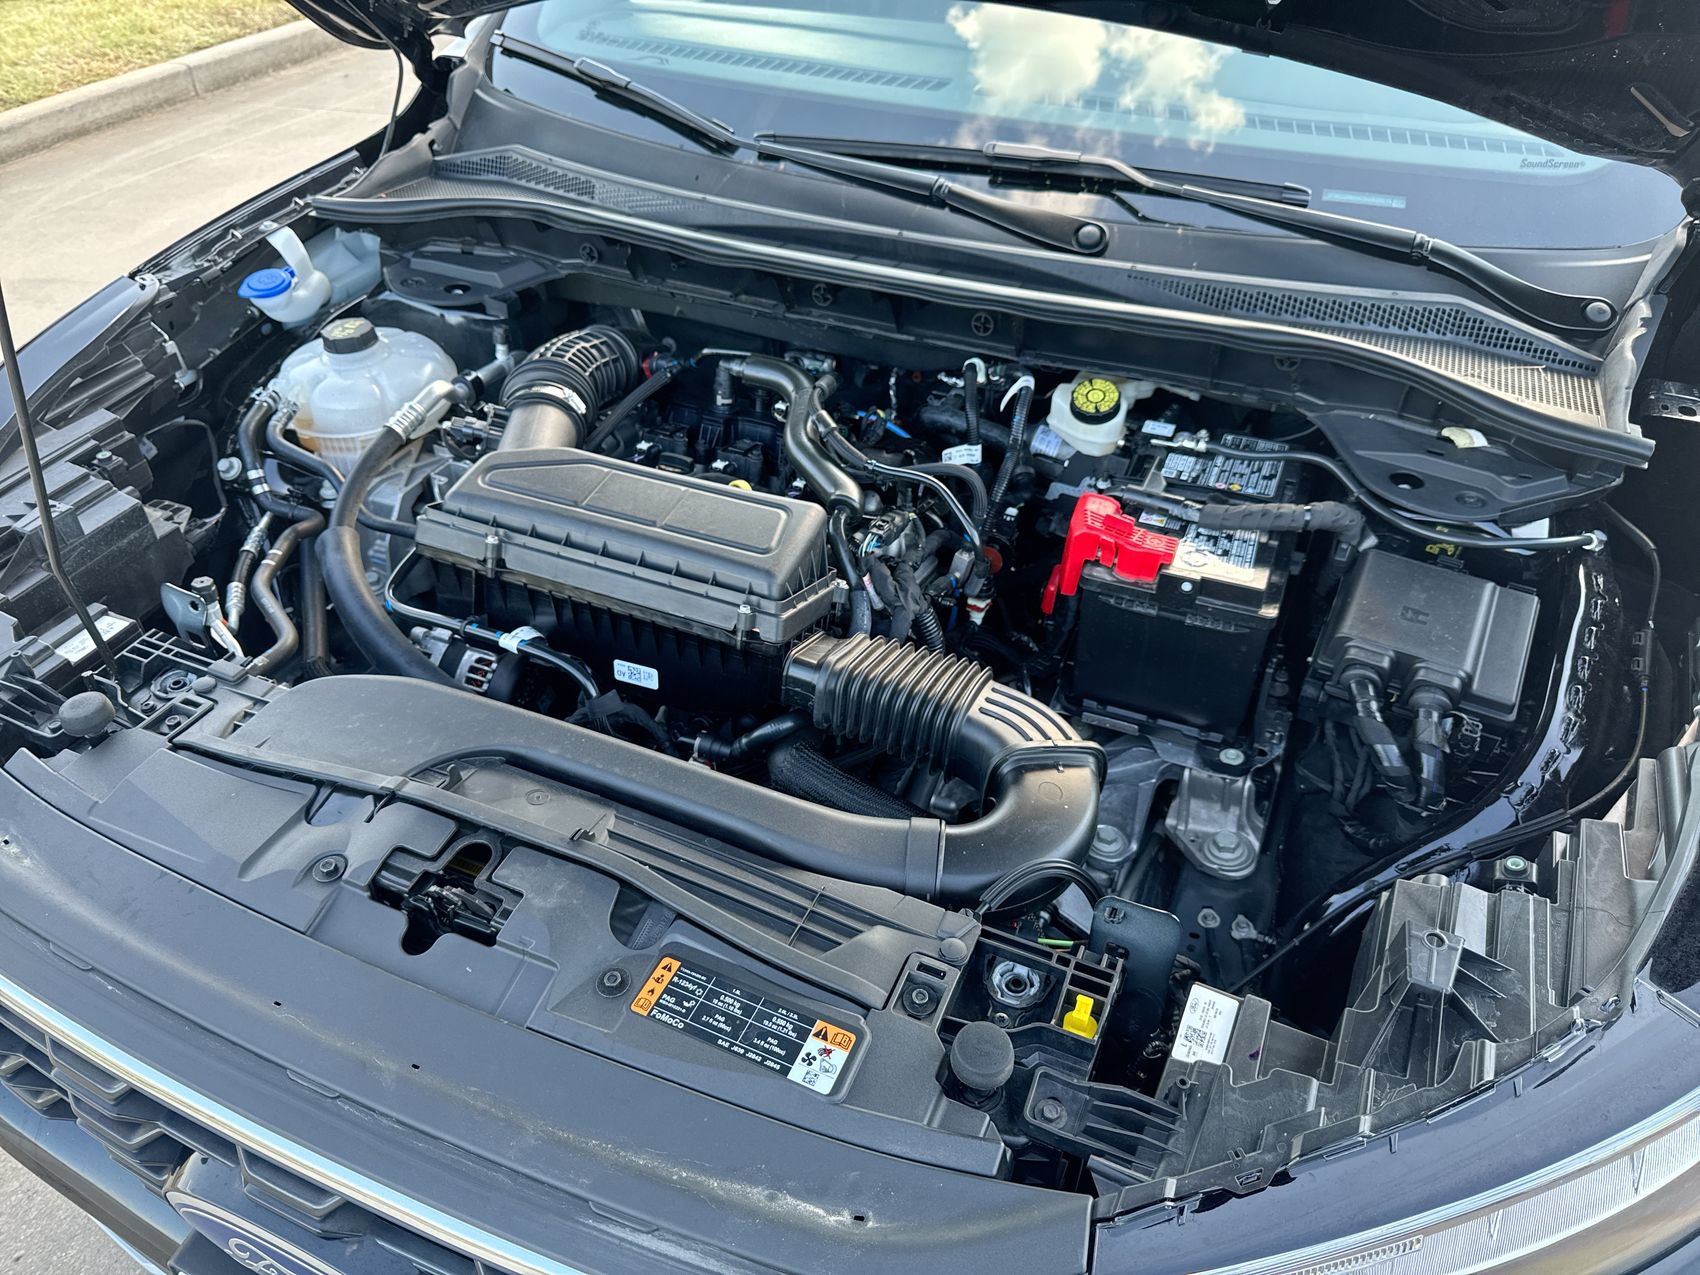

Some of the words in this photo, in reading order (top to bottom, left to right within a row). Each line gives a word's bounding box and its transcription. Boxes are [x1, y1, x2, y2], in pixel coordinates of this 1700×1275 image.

[662, 994, 676, 1003] PAG
[650, 1010, 686, 1029] FoMoCo
[714, 1014, 726, 1022] PAG
[785, 1022, 794, 1030] kg
[767, 1037, 778, 1045] PAG
[717, 1039, 730, 1048] SAE
[730, 1045, 745, 1054] J639
